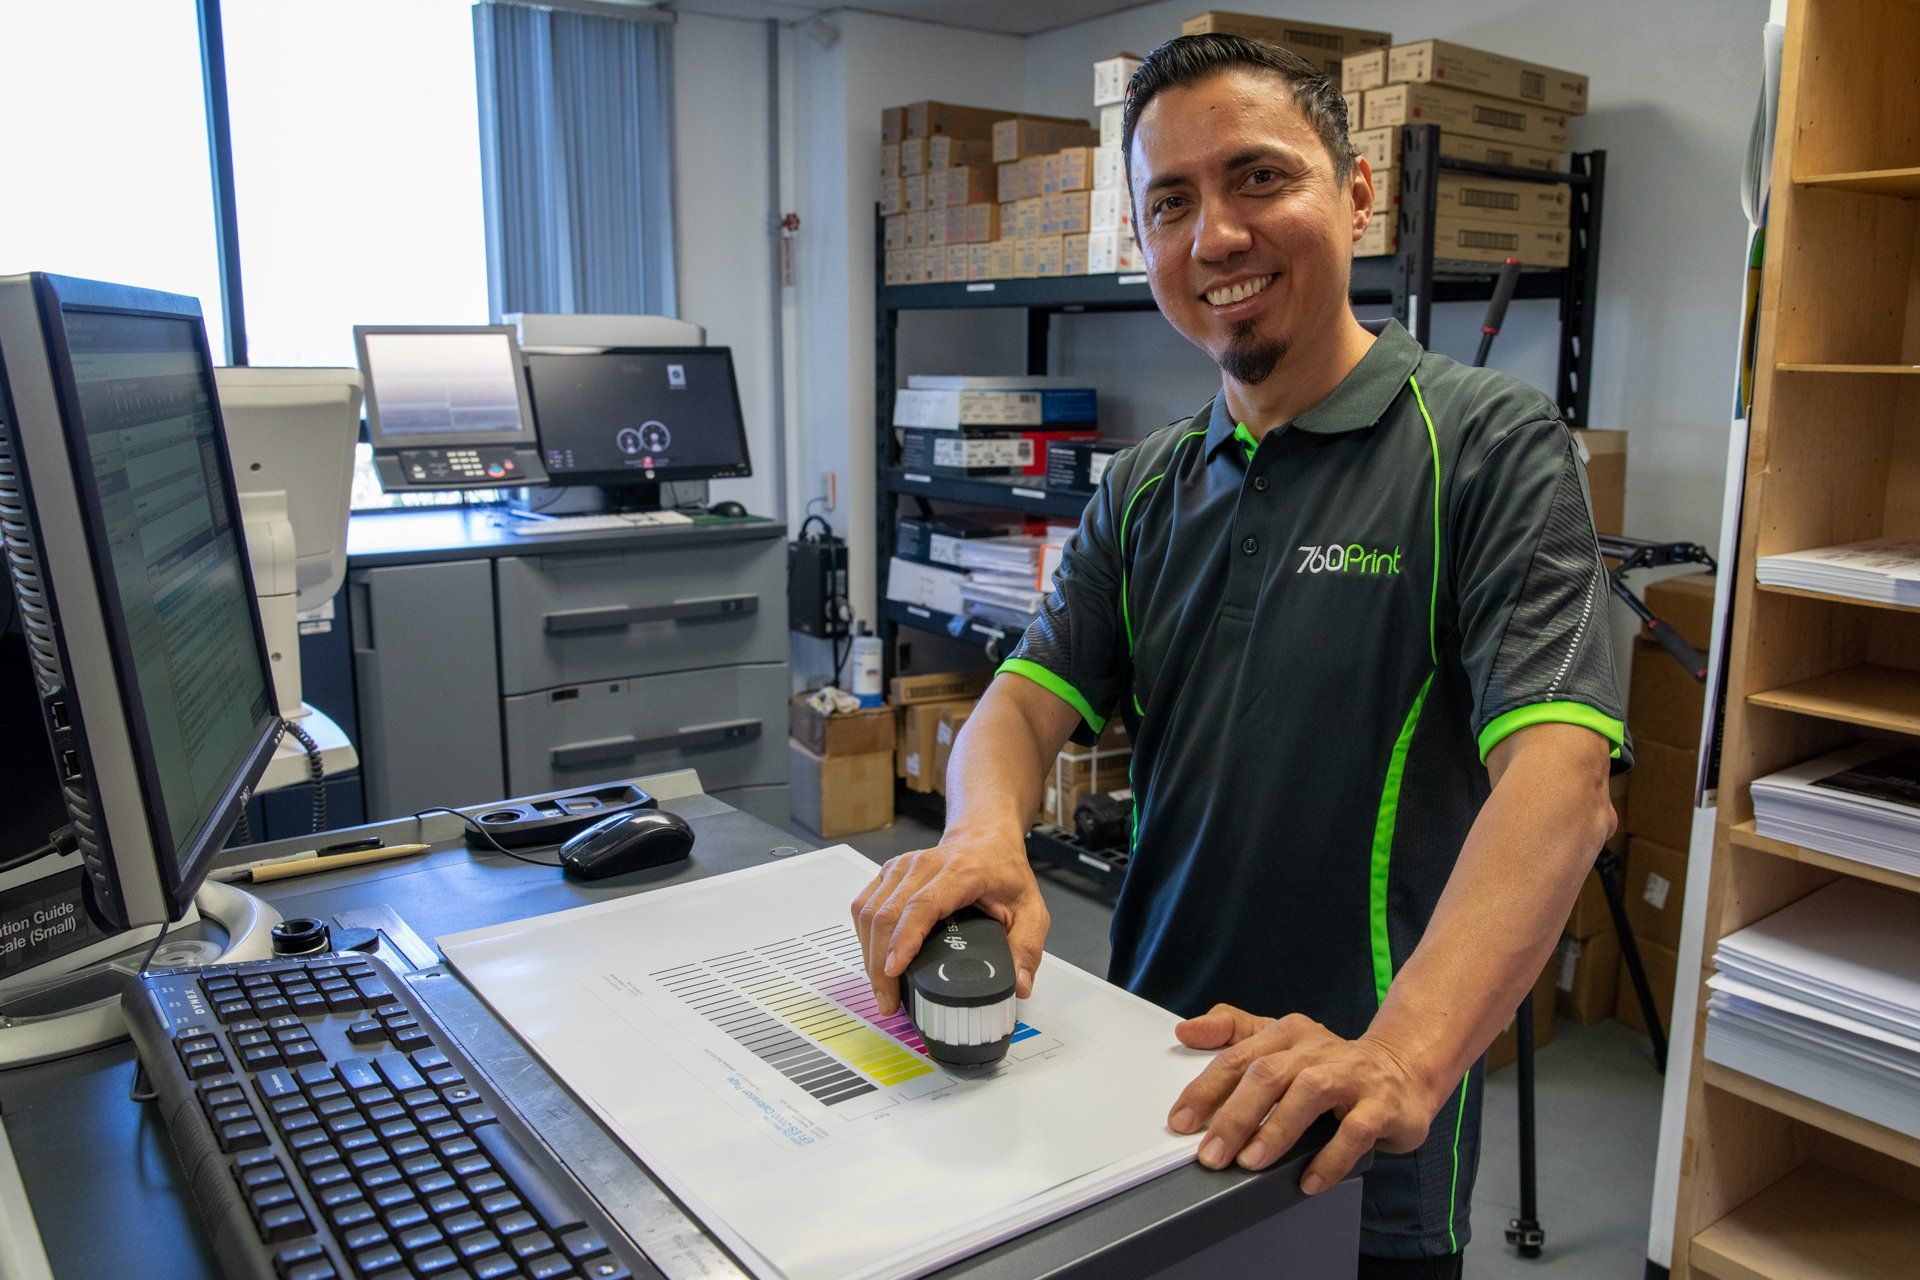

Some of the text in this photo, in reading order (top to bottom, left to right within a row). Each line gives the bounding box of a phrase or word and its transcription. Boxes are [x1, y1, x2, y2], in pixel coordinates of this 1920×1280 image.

[1297, 543, 1402, 575] 760Print
[34, 902, 75, 924] Guide
[30, 916, 77, 946] (Small)
[943, 935, 968, 950] efi
[185, 989, 206, 1015] DYNEX
